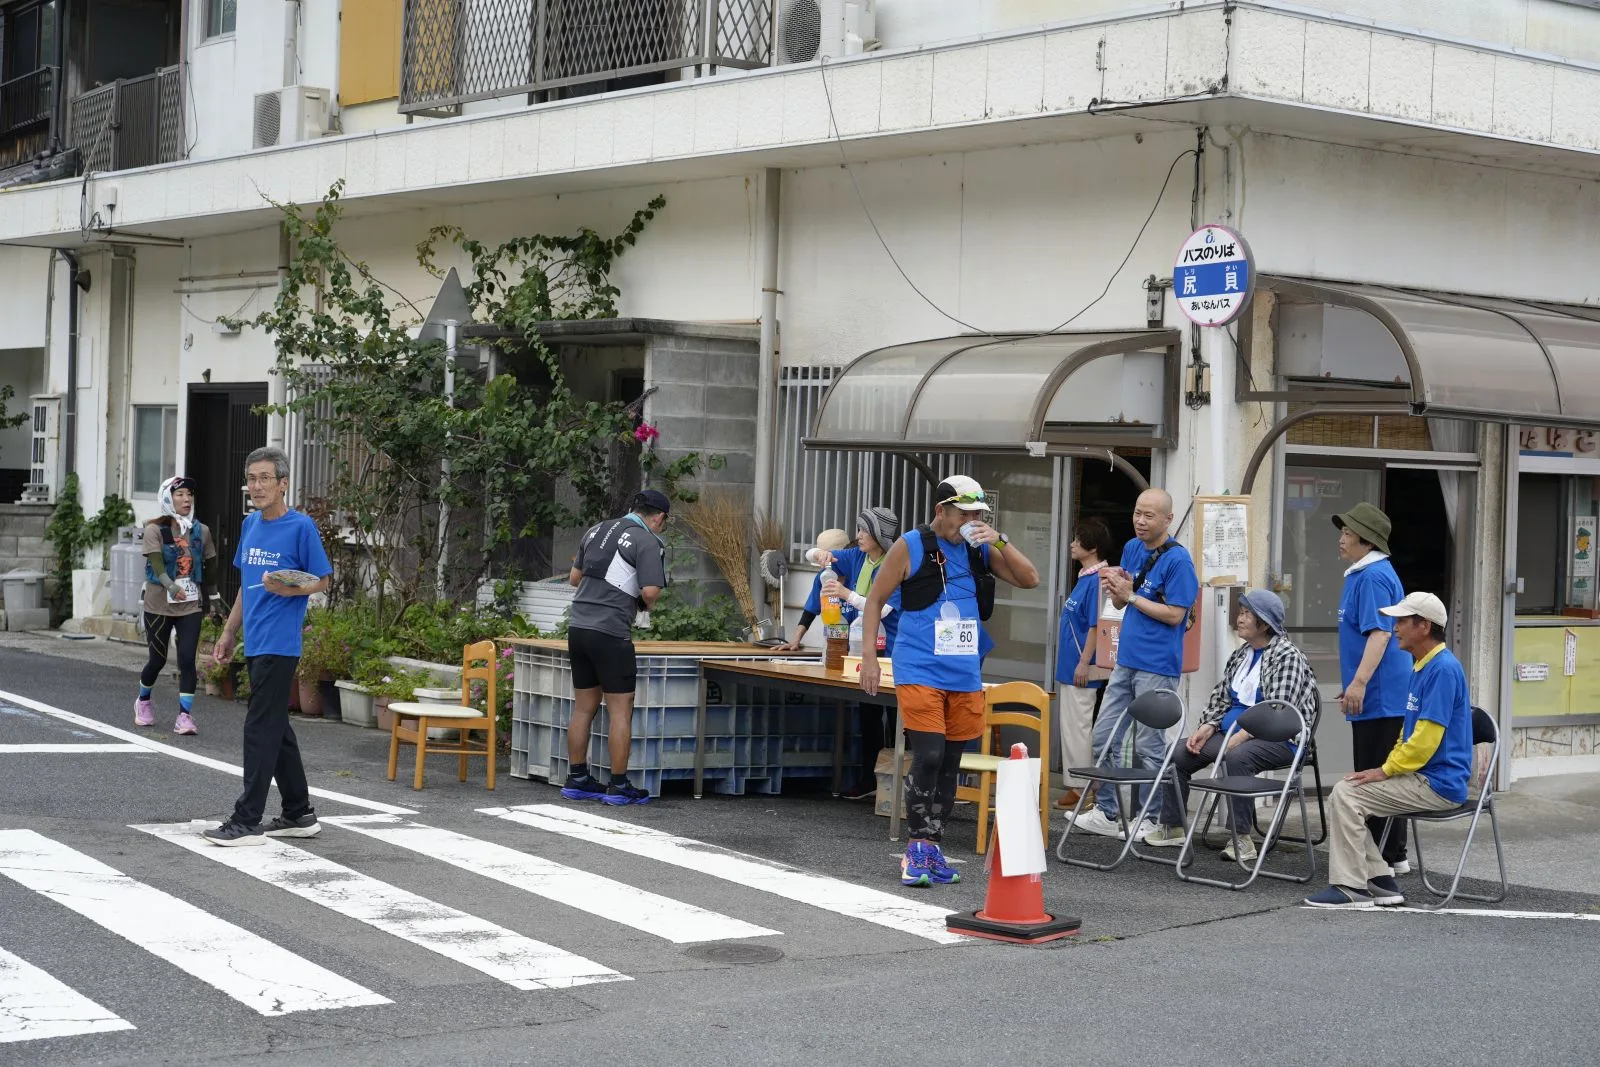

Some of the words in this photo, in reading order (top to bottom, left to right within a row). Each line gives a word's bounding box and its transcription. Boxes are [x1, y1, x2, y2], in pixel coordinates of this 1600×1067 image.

[1184, 243, 1236, 262] バスのりば
[1191, 298, 1230, 311] あいなんバス
[599, 521, 621, 549] SALOMON
[248, 556, 266, 566] 2026
[959, 631, 973, 643] 60
